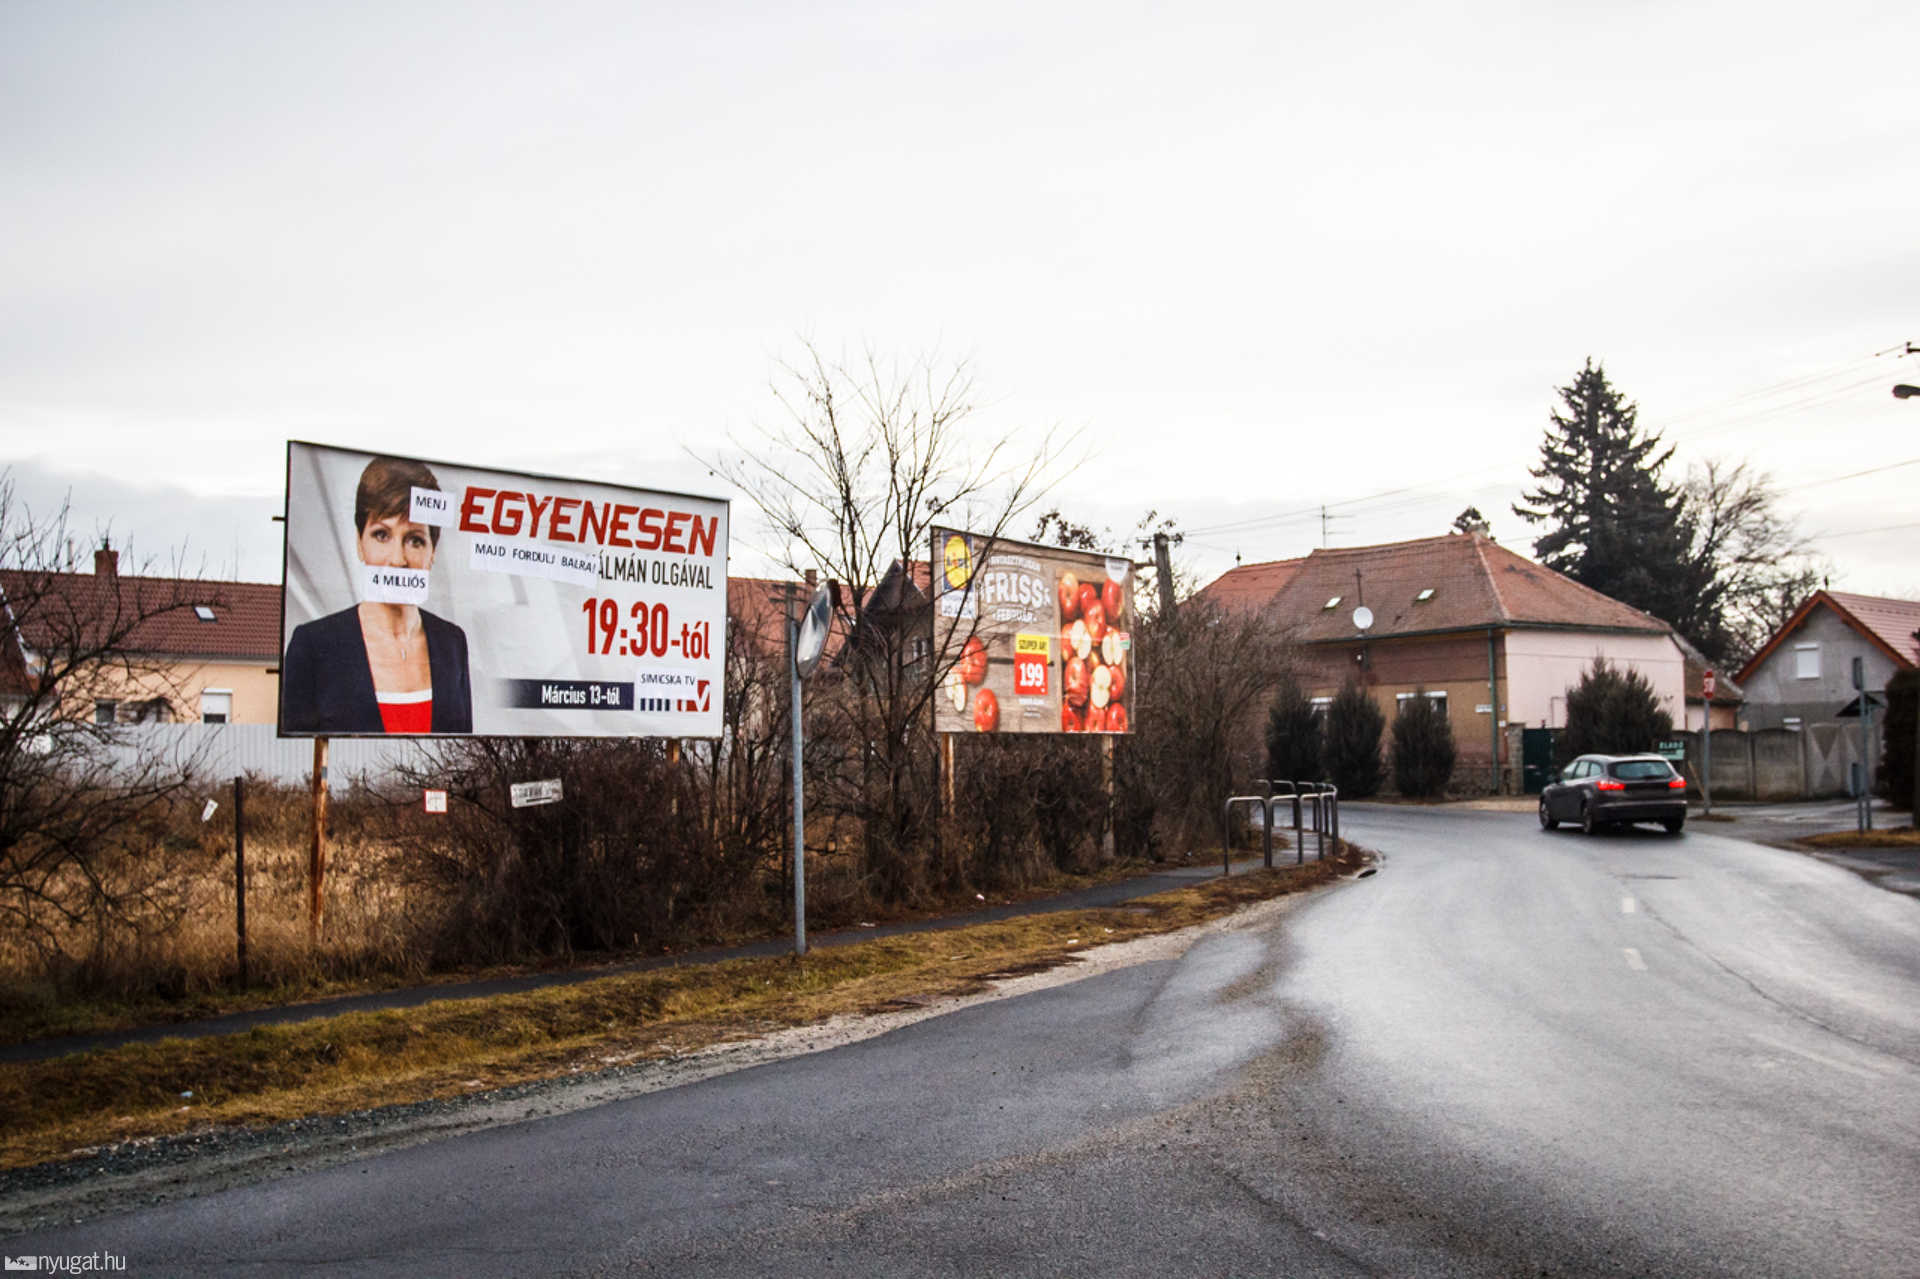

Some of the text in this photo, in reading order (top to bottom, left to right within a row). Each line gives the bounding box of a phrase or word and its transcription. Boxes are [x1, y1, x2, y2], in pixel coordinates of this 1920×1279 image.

[415, 495, 447, 511] MENJ
[459, 486, 719, 557] EGYENESEN
[475, 543, 597, 573] MAJD FORDULJ BALRA!
[593, 549, 713, 589] ÁLMÁN OLGÁVAL
[372, 574, 426, 589] 4 MILLIÓS
[984, 571, 1044, 608] FRISS
[582, 597, 710, 660] 19:30-tól
[640, 672, 696, 687] SIMICSKA TV
[1019, 662, 1044, 687] 199
[541, 684, 586, 704] Március
[589, 685, 620, 706] 13-tól
